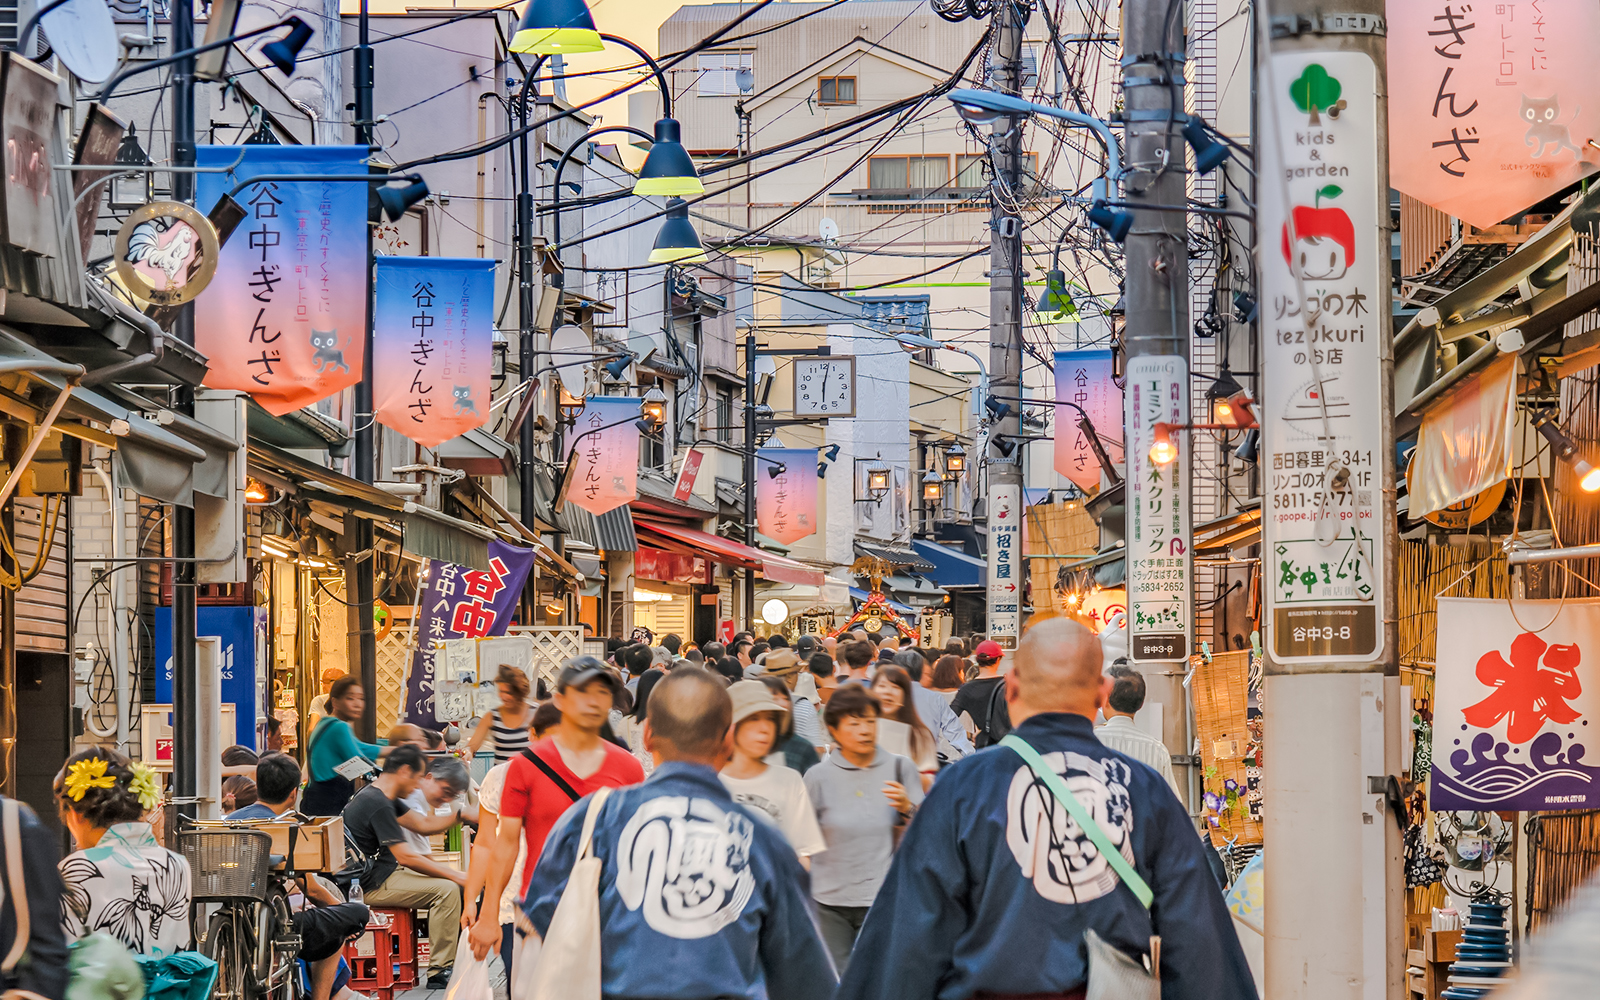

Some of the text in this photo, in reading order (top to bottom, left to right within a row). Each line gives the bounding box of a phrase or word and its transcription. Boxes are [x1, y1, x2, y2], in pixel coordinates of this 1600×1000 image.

[1427, 0, 1480, 178] ぎんざ
[1296, 131, 1335, 145] kids
[1309, 149, 1321, 161] &
[1286, 164, 1349, 182] garden
[247, 182, 283, 386] 谷中ぎんざ
[1274, 287, 1369, 321] リンゴの木
[1276, 324, 1364, 346] tezukuri
[408, 281, 436, 423] 谷中ぎんざ
[1293, 348, 1344, 365] のお店
[831, 400, 838, 408] 5
[585, 411, 603, 500] 谷中ぎんざ
[1273, 450, 1372, 470] 西日暮里-34-1
[773, 461, 788, 534] 中ぎんざ
[1273, 491, 1353, 509] 5811-577
[1273, 509, 1373, 523] r.goope.jp/rgooki
[996, 533, 1012, 579] 招き屋
[450, 556, 511, 640] 谷中
[1293, 626, 1351, 642] 谷中3-8
